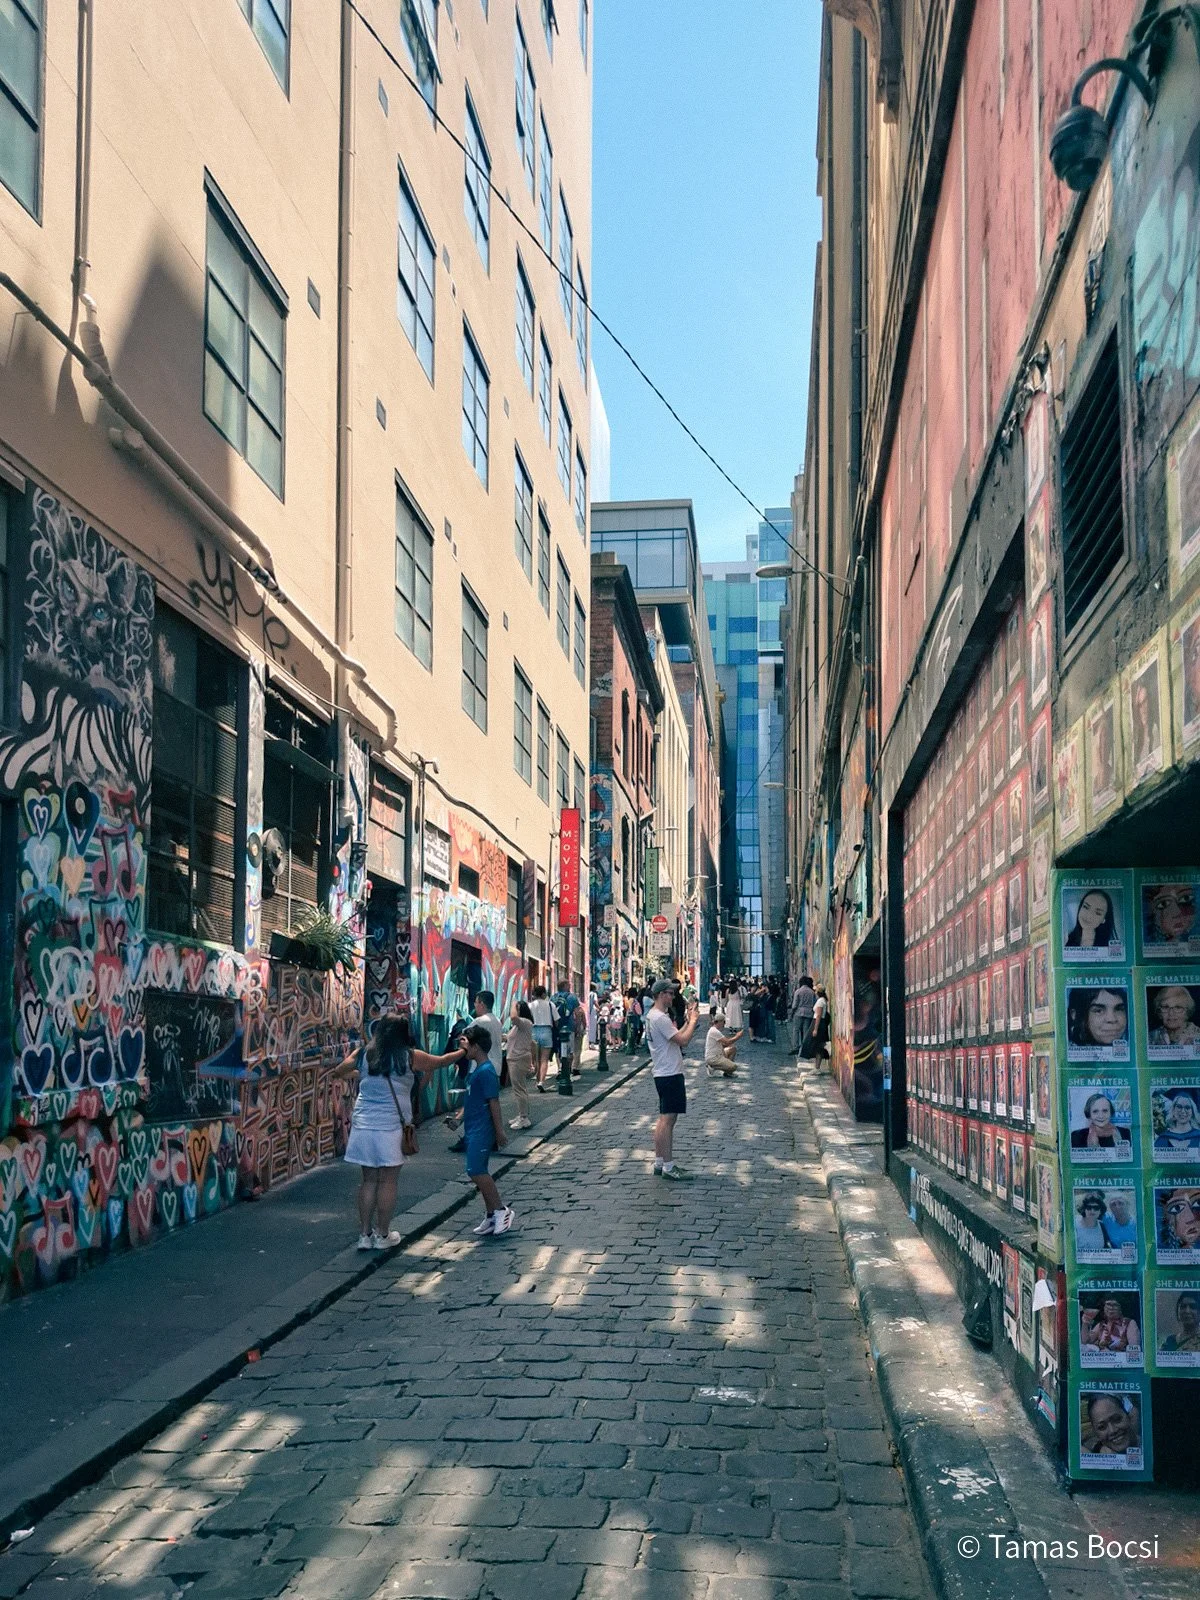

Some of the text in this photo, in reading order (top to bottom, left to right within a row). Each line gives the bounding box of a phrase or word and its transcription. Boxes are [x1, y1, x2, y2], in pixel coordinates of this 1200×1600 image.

[562, 830, 572, 904] MOVIDA
[241, 1068, 336, 1129] LIGHT
[257, 1122, 335, 1185] PEACE
[1099, 1382, 1141, 1390] MATTERS
